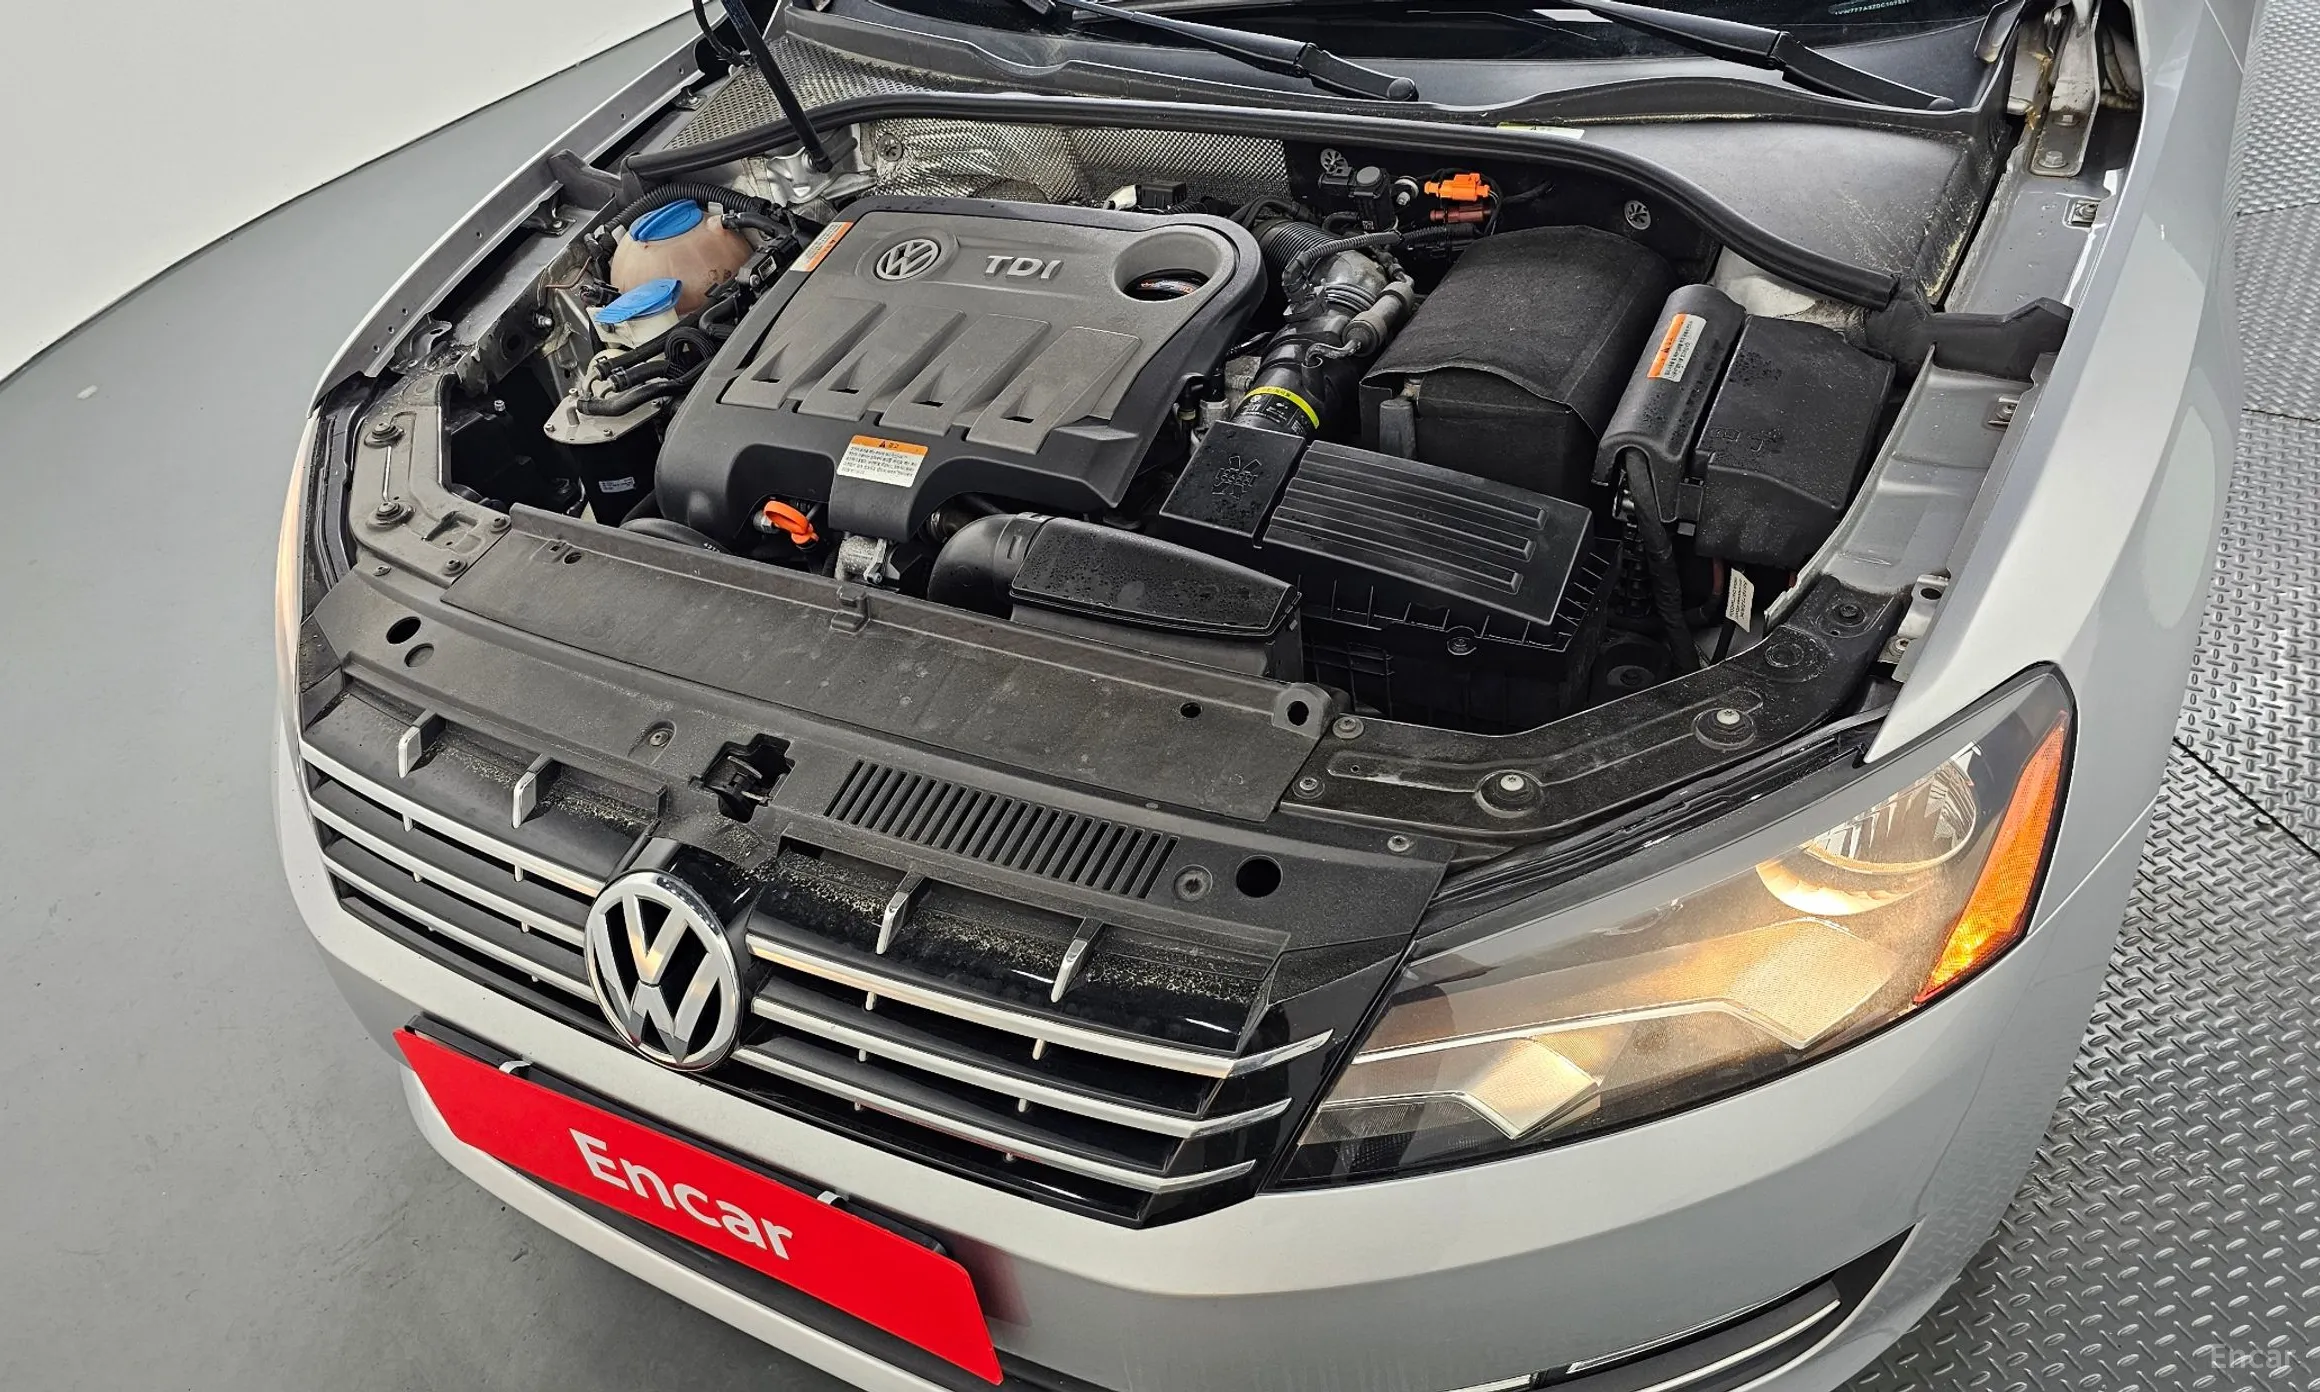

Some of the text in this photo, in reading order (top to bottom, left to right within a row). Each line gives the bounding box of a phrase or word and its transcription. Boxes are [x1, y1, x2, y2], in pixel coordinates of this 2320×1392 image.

[985, 255, 1064, 281] TDI
[584, 872, 740, 1071] VW
[568, 1127, 794, 1261] Encar
